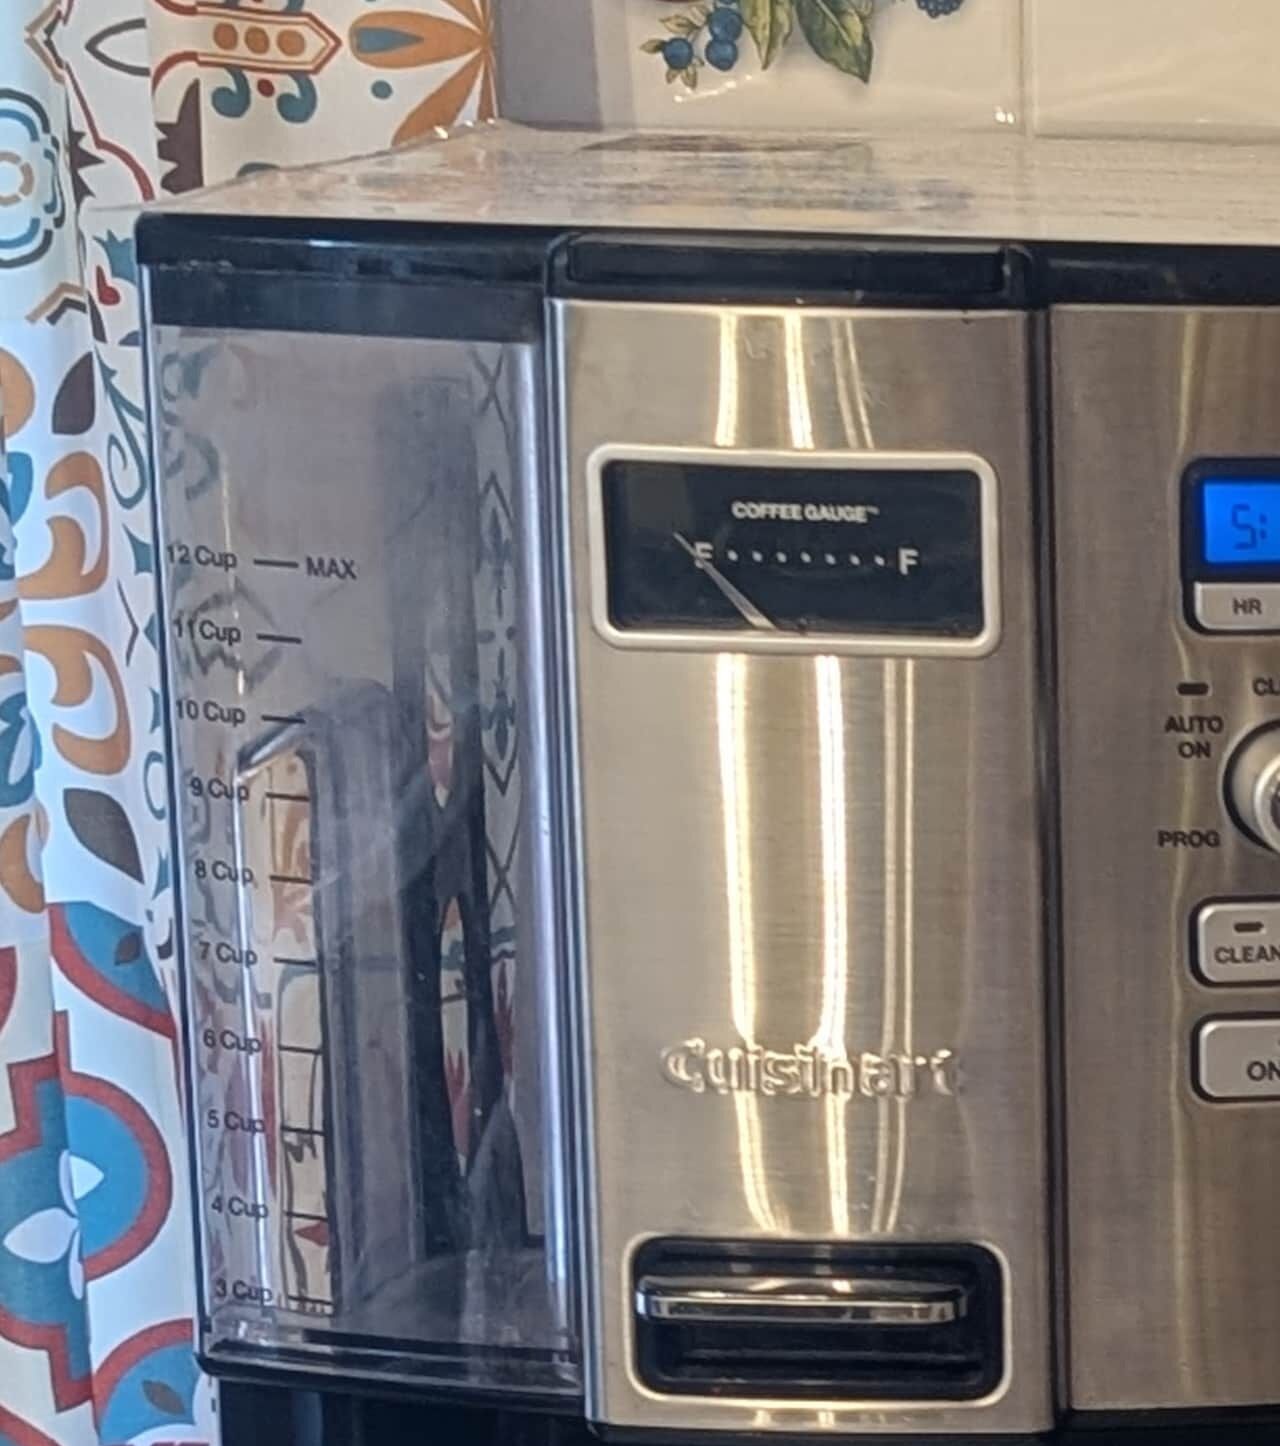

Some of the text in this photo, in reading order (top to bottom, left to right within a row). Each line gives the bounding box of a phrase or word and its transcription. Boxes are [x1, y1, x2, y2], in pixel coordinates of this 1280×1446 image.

[731, 501, 802, 520] COFFEE
[167, 544, 237, 571] 12 Cup
[305, 556, 357, 580] MAX
[899, 547, 919, 576] F
[1232, 597, 1263, 615] HR
[199, 619, 241, 646] Cup
[176, 699, 245, 727] 10 Cup
[1164, 715, 1225, 735] AUTO
[1177, 740, 1212, 760] ON
[190, 776, 249, 804] 9 Cup
[1157, 829, 1222, 849] PROG
[194, 859, 253, 888] 8 Cup
[198, 941, 258, 969] 7 Cup
[203, 1029, 262, 1056] 6 Cup
[659, 1036, 954, 1099] Cuisinart
[207, 1108, 266, 1137] 5 Cup
[210, 1193, 270, 1223] 4 Cup
[215, 1278, 273, 1306] 3 Cup
